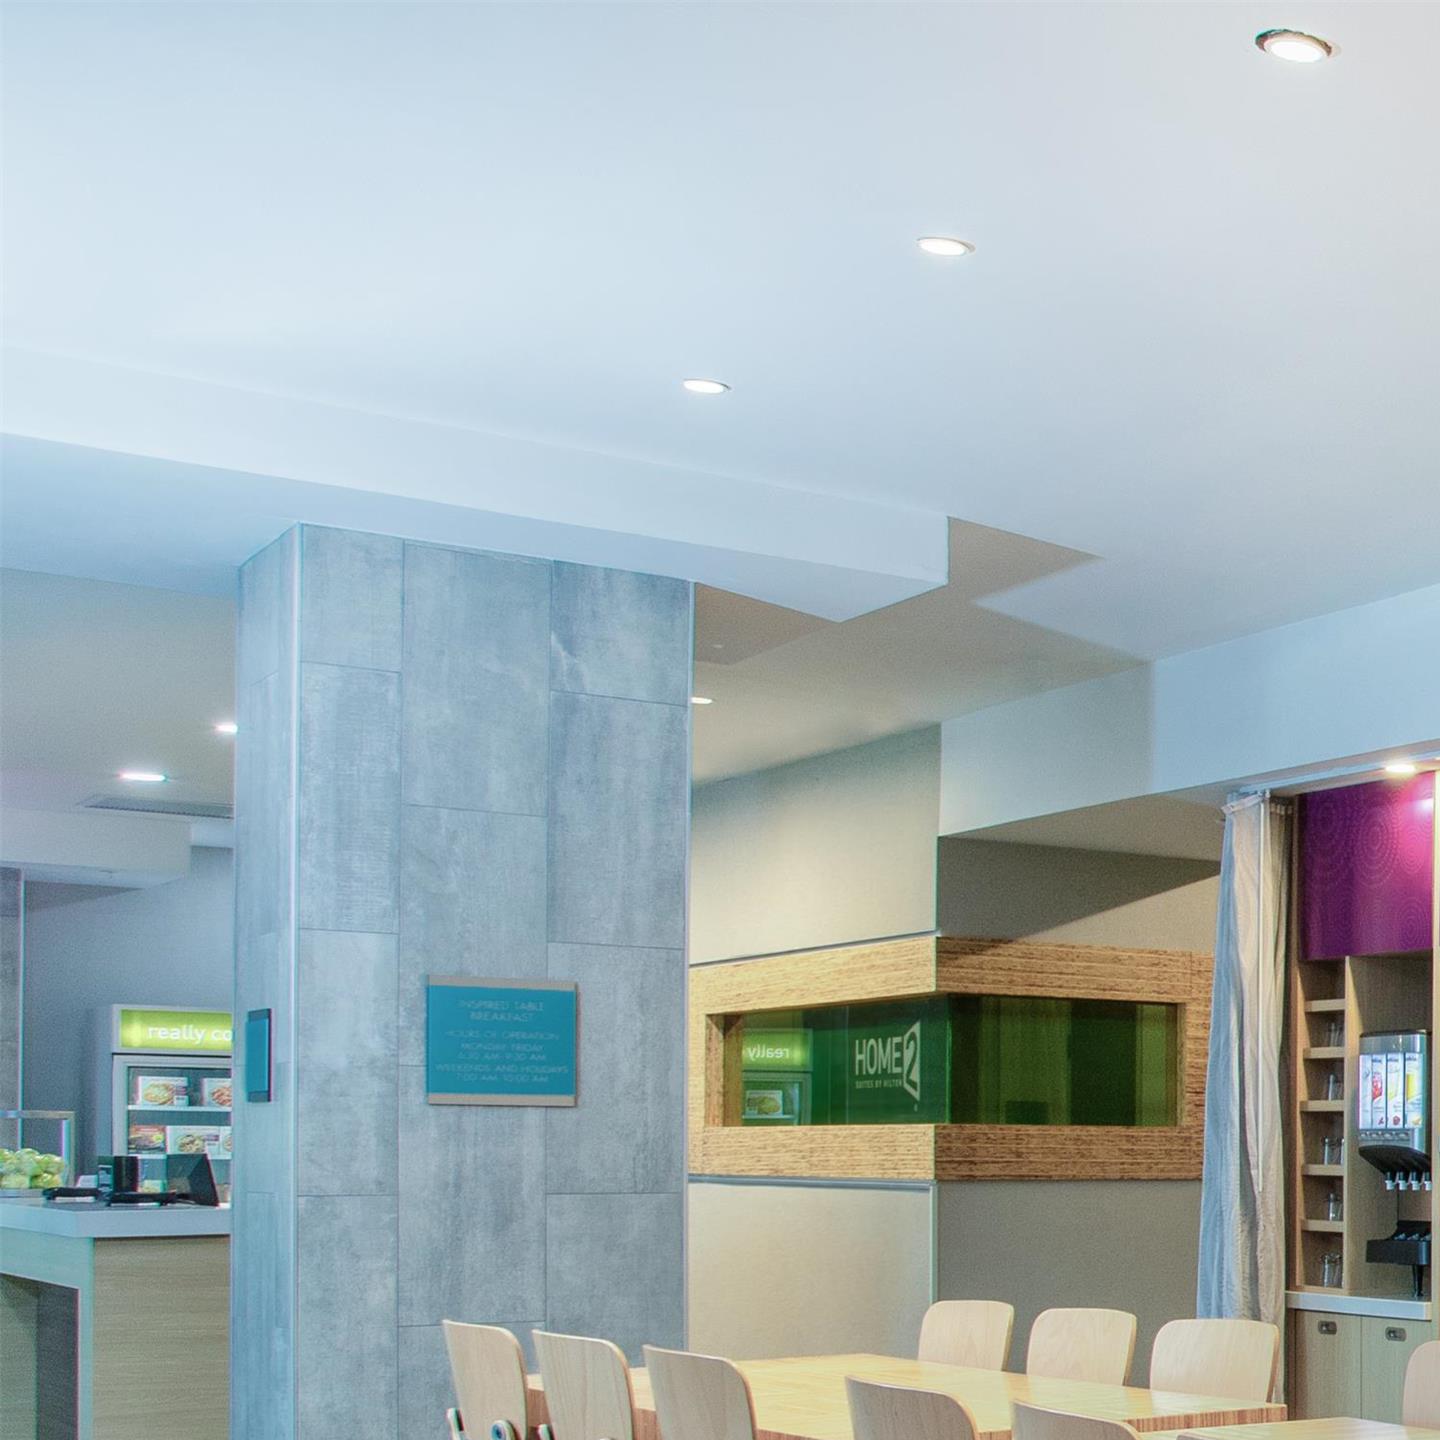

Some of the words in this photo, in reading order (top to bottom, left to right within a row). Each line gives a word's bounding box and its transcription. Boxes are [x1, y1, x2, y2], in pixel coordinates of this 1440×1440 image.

[457, 1000, 509, 1011] INSPIRED
[513, 1001, 545, 1012] TABLE
[469, 1011, 534, 1022] BREAKFAST
[147, 1024, 206, 1045] really
[501, 1031, 561, 1041] OPERATION
